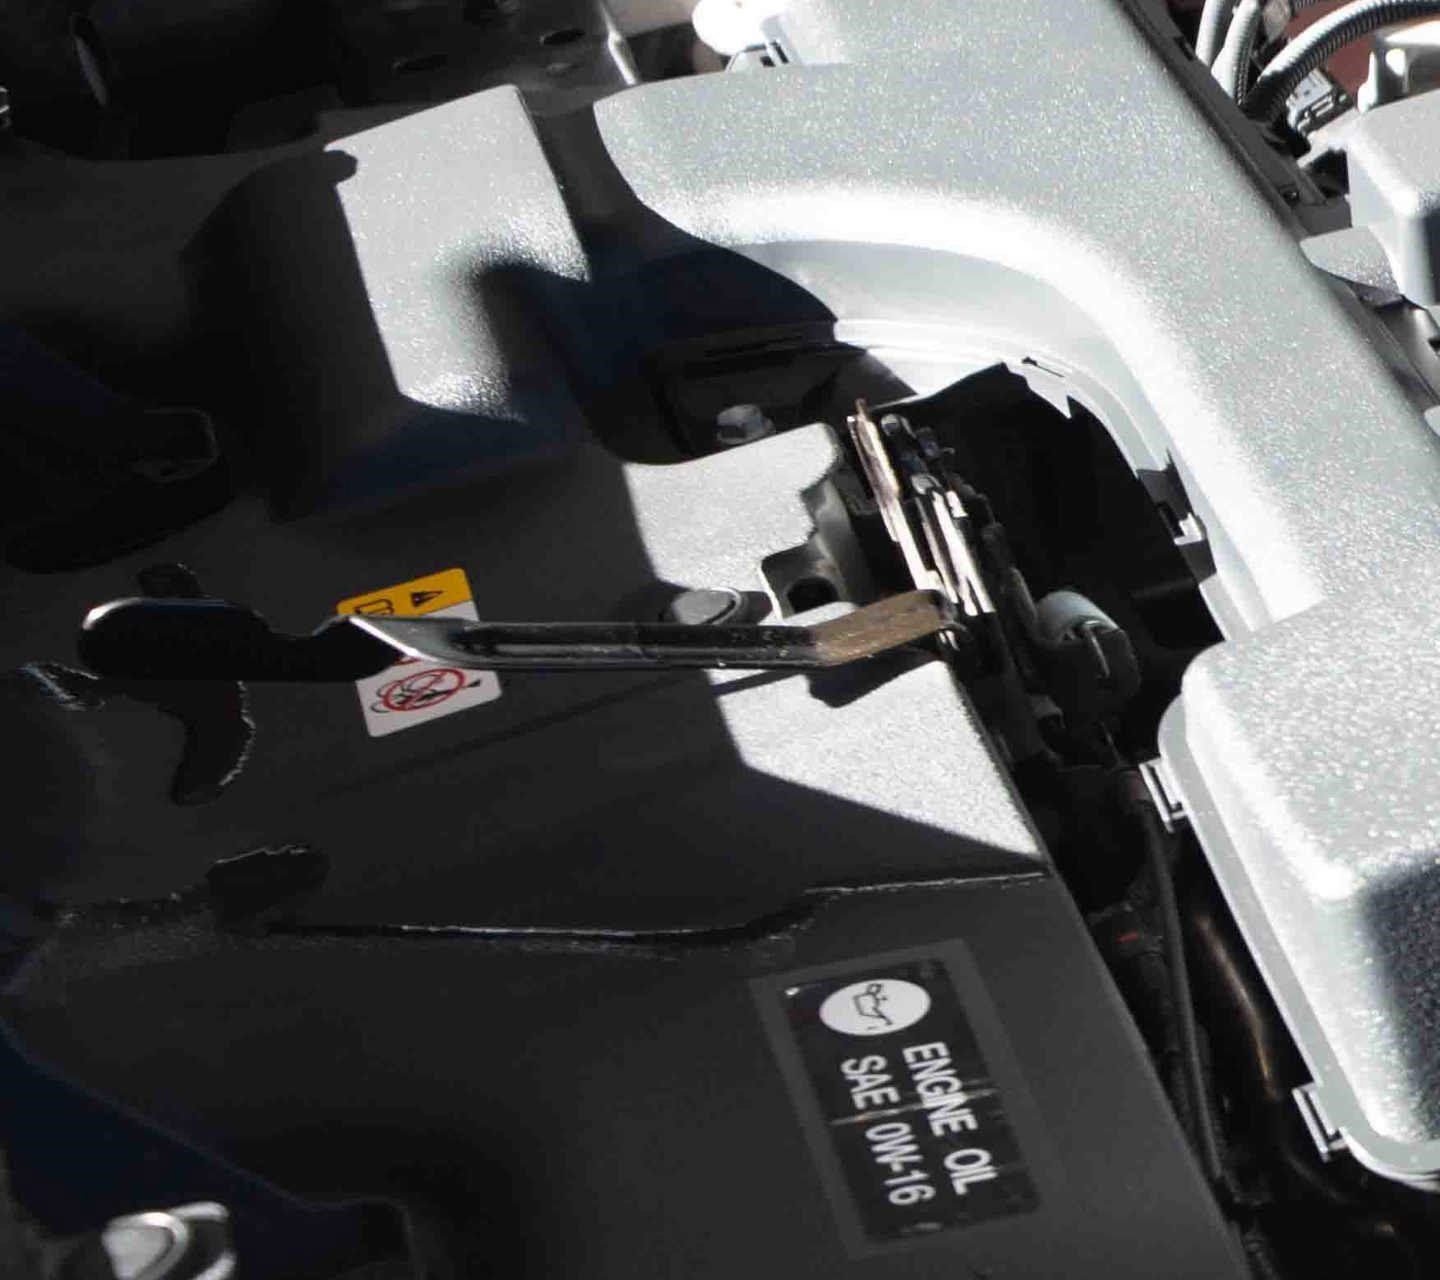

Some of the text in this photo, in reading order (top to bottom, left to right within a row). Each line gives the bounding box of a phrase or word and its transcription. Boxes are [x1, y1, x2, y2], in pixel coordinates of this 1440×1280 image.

[841, 1055, 936, 1206] SAE 0W-16
[903, 1041, 998, 1195] ENGINE OIL
